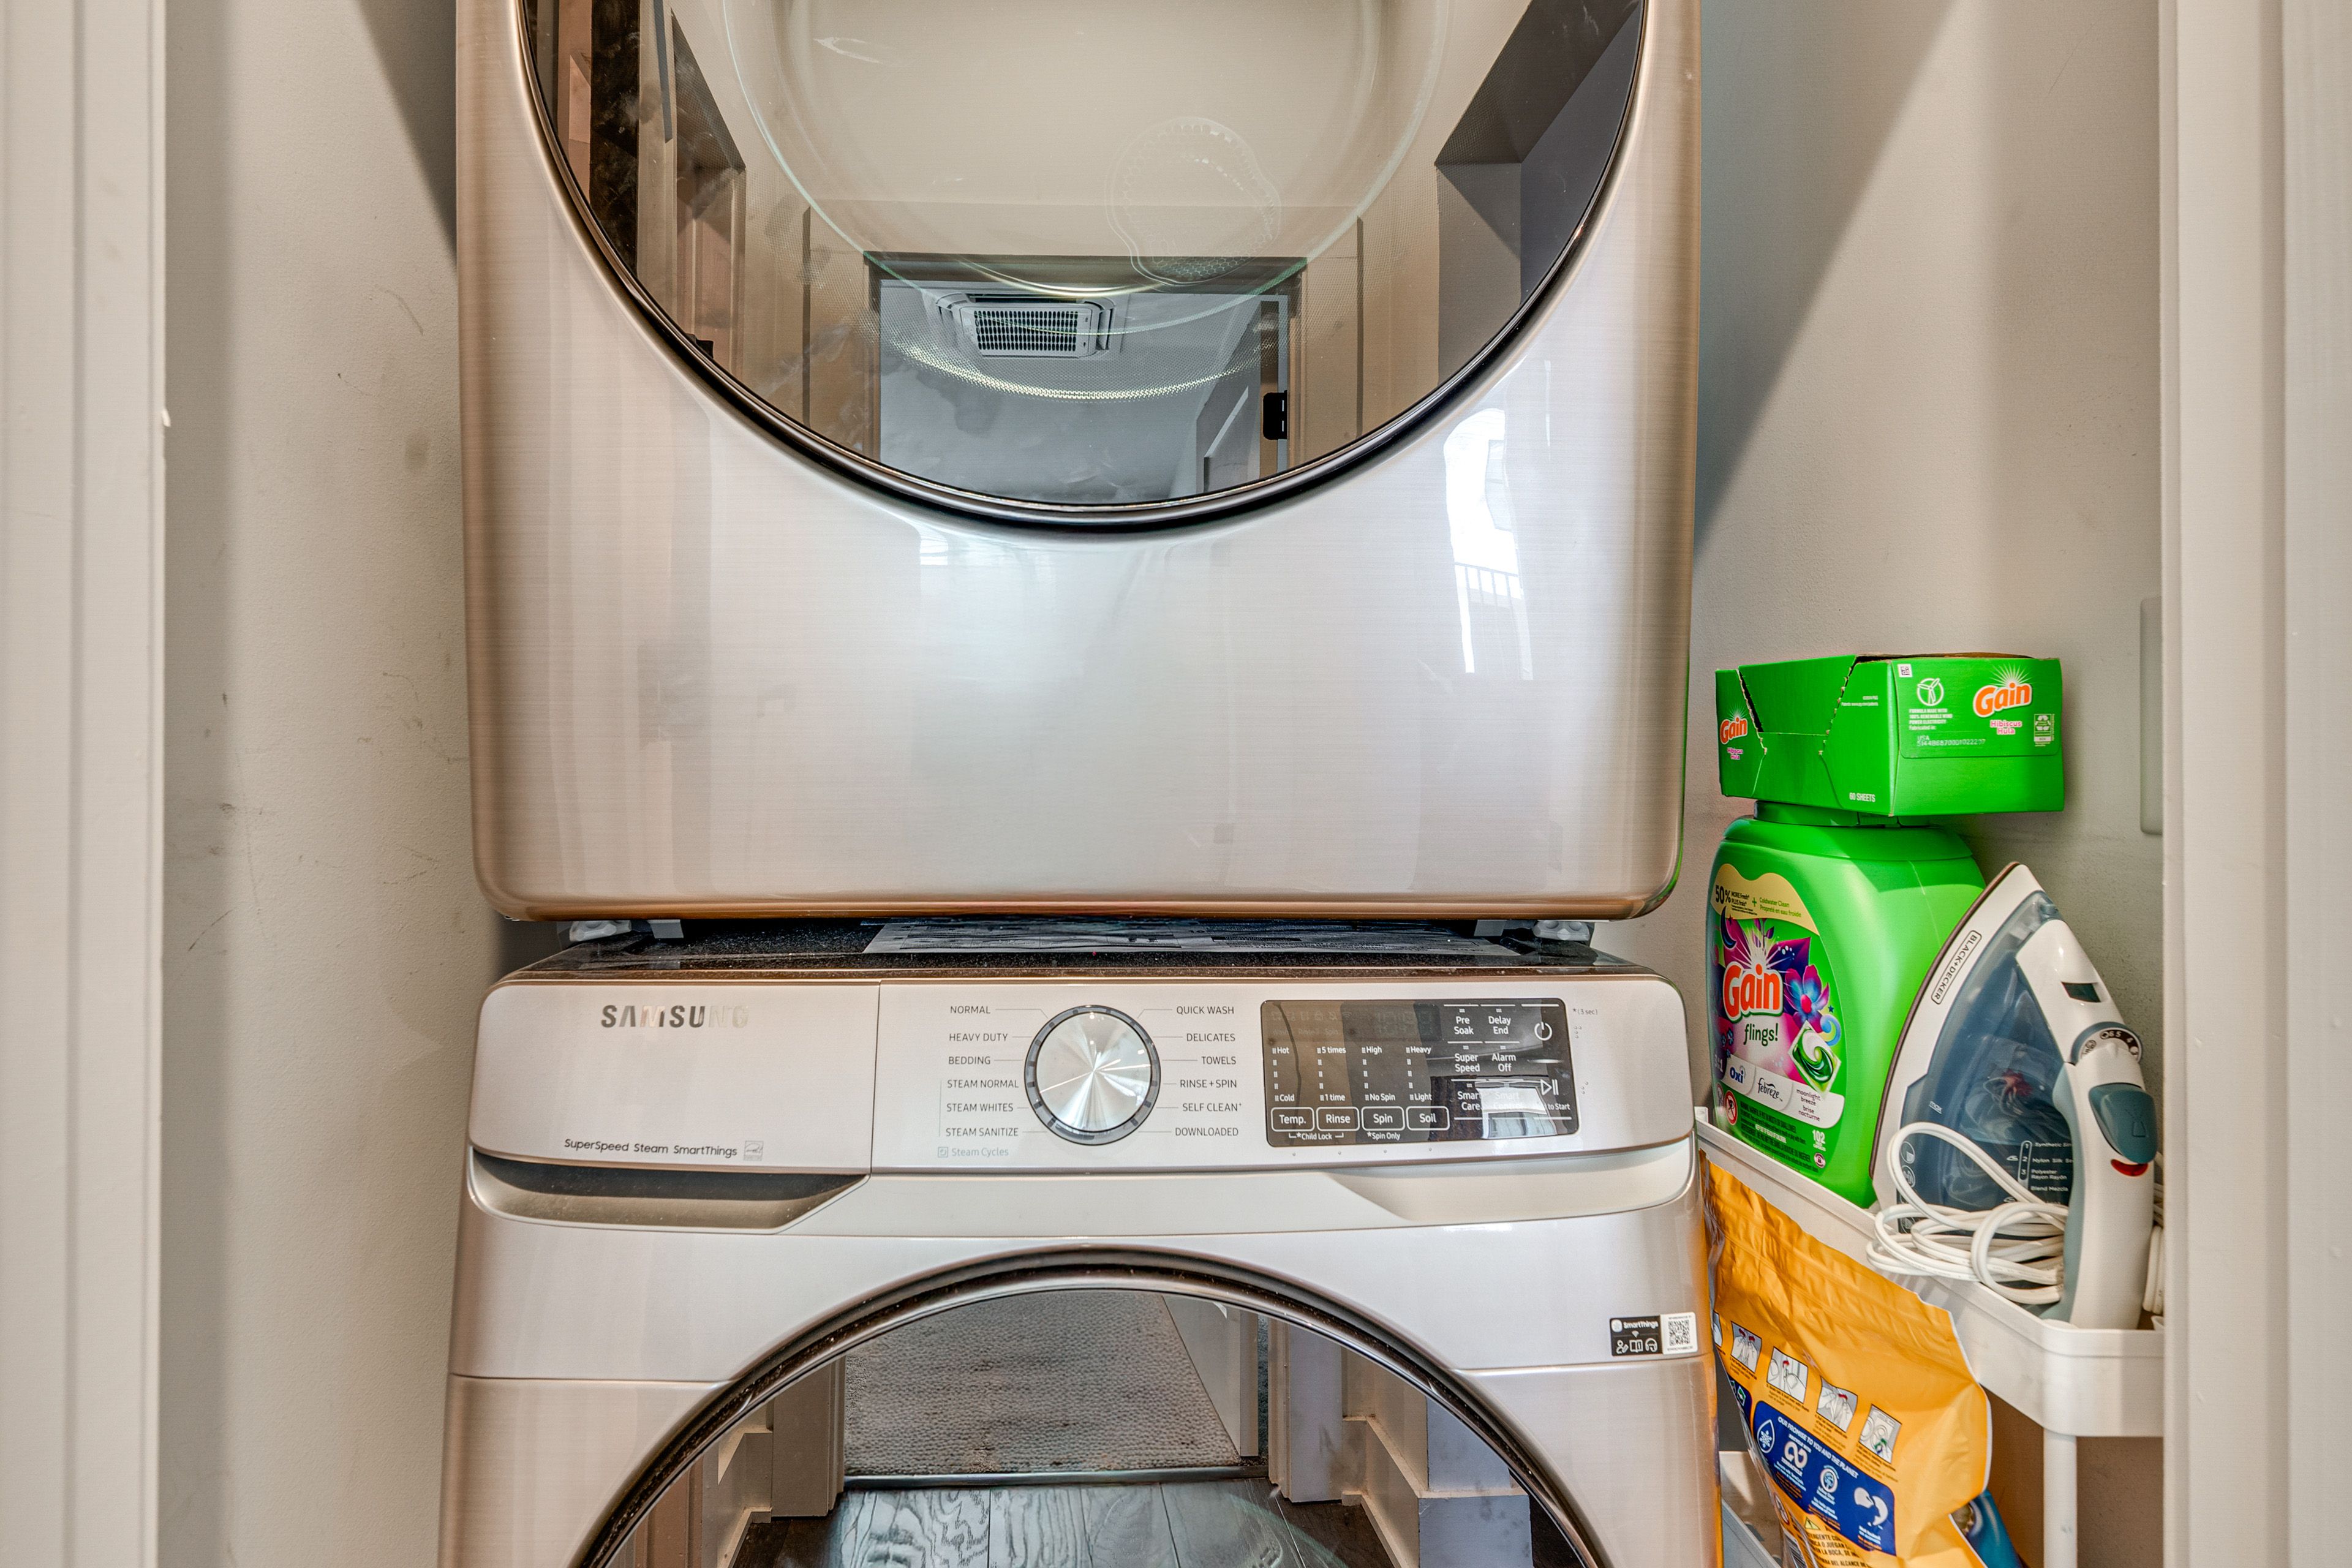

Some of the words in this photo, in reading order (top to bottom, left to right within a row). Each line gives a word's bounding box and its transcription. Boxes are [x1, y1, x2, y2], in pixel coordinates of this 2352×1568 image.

[1974, 682, 2031, 717] Gain
[1720, 717, 1747, 744] Gain
[1856, 793, 1875, 802] SHEETS
[1716, 884, 1731, 904] 50%
[1935, 935, 1977, 1000] BLACK+DECKER
[1724, 963, 1781, 1019] Gain
[1176, 1006, 1205, 1015] QUICK
[601, 1005, 748, 1028] SAMSUNG
[1456, 1016, 1470, 1024] Pre
[1488, 1016, 1511, 1025] Delay
[1743, 1023, 1778, 1046] flings!
[1366, 1046, 1382, 1055] High
[1411, 1046, 1431, 1055] Heavy
[949, 1056, 990, 1065] BEDDING
[1201, 1056, 1236, 1065] TOWELS
[1455, 1053, 1479, 1063] Super
[1455, 1063, 1480, 1073] Speed
[1498, 1063, 1512, 1072] Off
[1730, 1068, 1744, 1084] Oxi
[948, 1079, 978, 1088] STEAM
[980, 1079, 1019, 1088] NORMAL
[1180, 1079, 1207, 1088] RINSE
[1216, 1079, 1237, 1088] SPIN
[1758, 1078, 1779, 1099] febreze
[1381, 1093, 1395, 1102] Spin
[1414, 1093, 1432, 1102] Light
[1457, 1091, 1483, 1099] Smart
[1796, 1089, 1820, 1101] moonlight
[1801, 1097, 1816, 1106] breeze
[947, 1103, 976, 1112] STEAM
[979, 1103, 1013, 1112] WHITES
[1182, 1103, 1204, 1112] SELF
[1803, 1105, 1814, 1114] brise
[1325, 1114, 1351, 1123] Rinse
[1373, 1114, 1393, 1125] Spin
[1419, 1113, 1437, 1123] Soil
[1798, 1110, 1820, 1121] nocturne
[1279, 1115, 1306, 1126] Temp.
[946, 1128, 976, 1136] STEAM
[979, 1128, 1019, 1136] SANITIZE
[1175, 1127, 1238, 1136] DOWNLOADED
[1387, 1132, 1401, 1141] Only
[1812, 1129, 1825, 1144] 102
[564, 1139, 629, 1153] SuperSpeed
[633, 1144, 668, 1153] Steam
[673, 1145, 737, 1158] SmartThings
[951, 1148, 979, 1156] Steam
[981, 1147, 1009, 1158] Cycles
[1777, 1416, 1788, 1427] OUR
[1787, 1423, 1807, 1441] PROMISE
[1813, 1441, 1822, 1452] YOU
[1821, 1447, 1832, 1459] AND
[1839, 1460, 1859, 1479] PLANET
